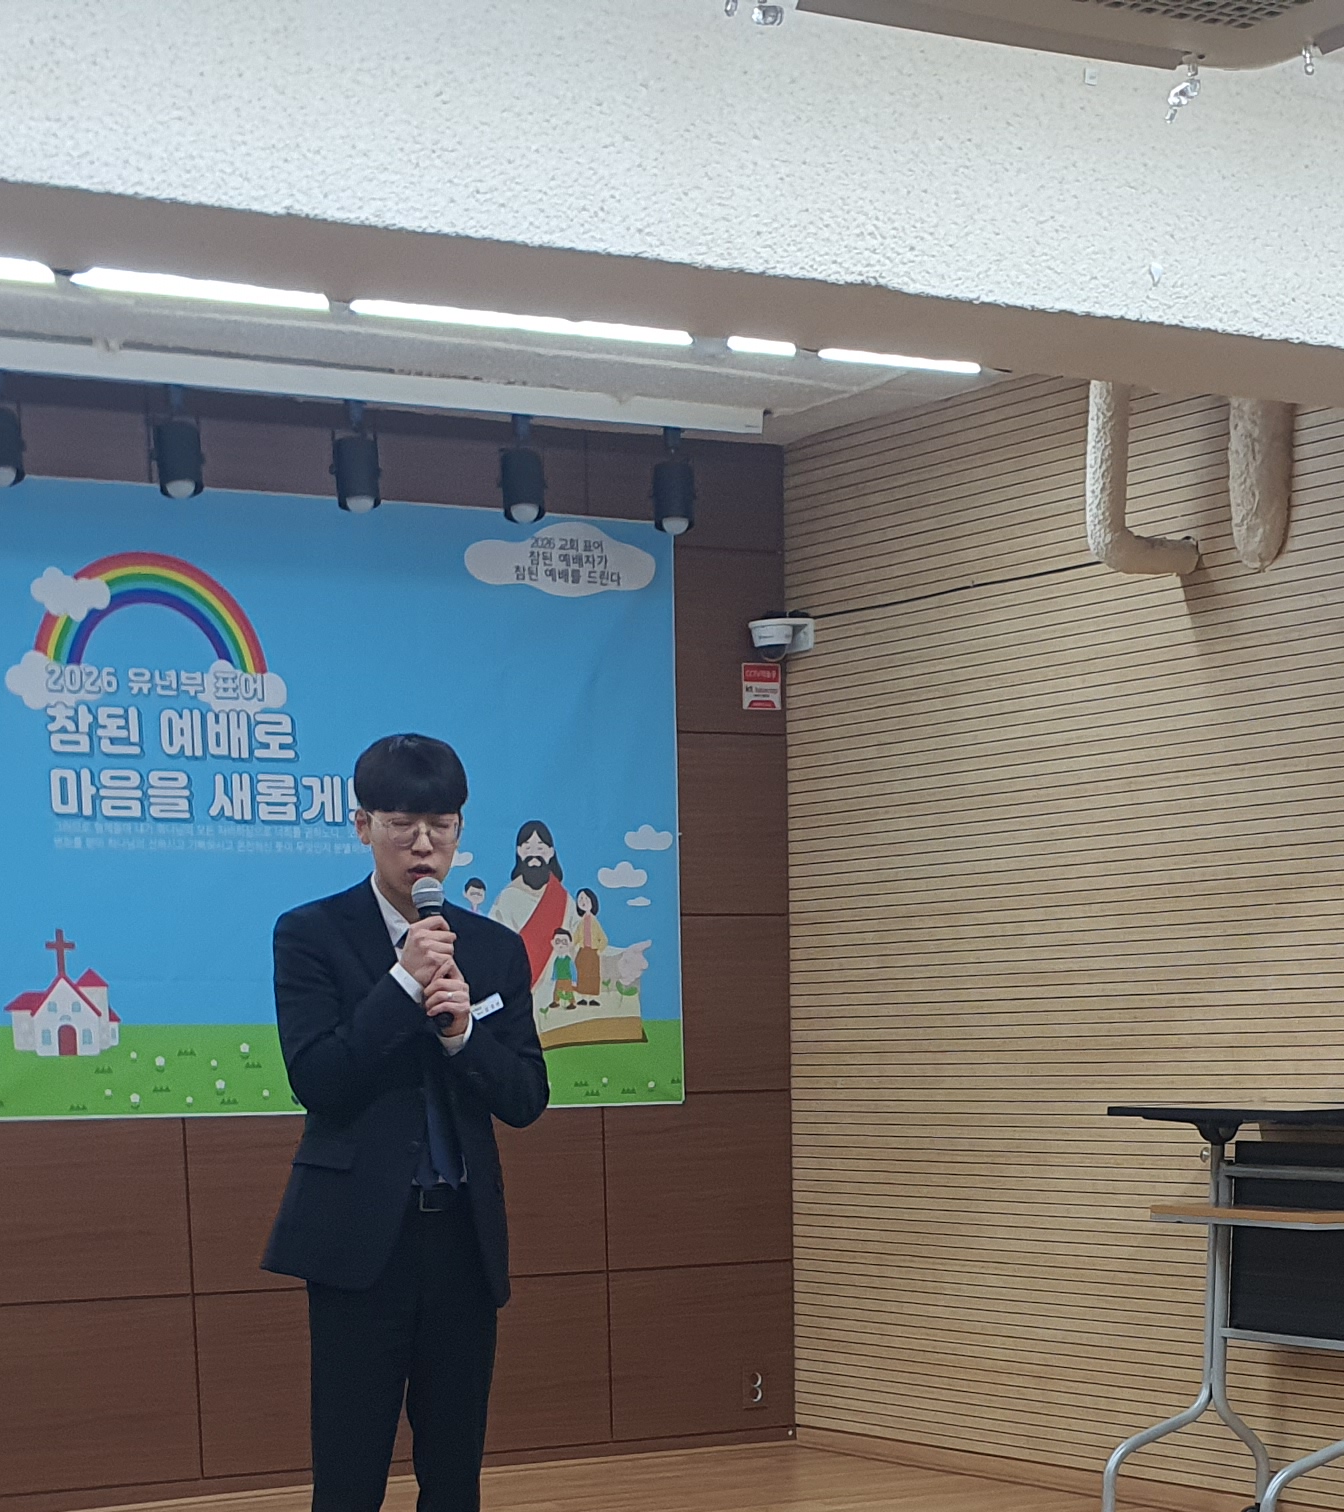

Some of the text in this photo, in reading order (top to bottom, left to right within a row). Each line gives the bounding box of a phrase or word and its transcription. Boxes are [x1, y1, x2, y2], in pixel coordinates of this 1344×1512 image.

[529, 550, 607, 569] 참된 예배자가
[558, 538, 579, 552] 교회
[583, 539, 603, 553] 표어
[515, 565, 621, 586] 참된 예배를 드린다
[45, 663, 265, 702] 2026 유년부 표어
[46, 702, 299, 762] 참된 예배로
[49, 767, 194, 821] 마음을
